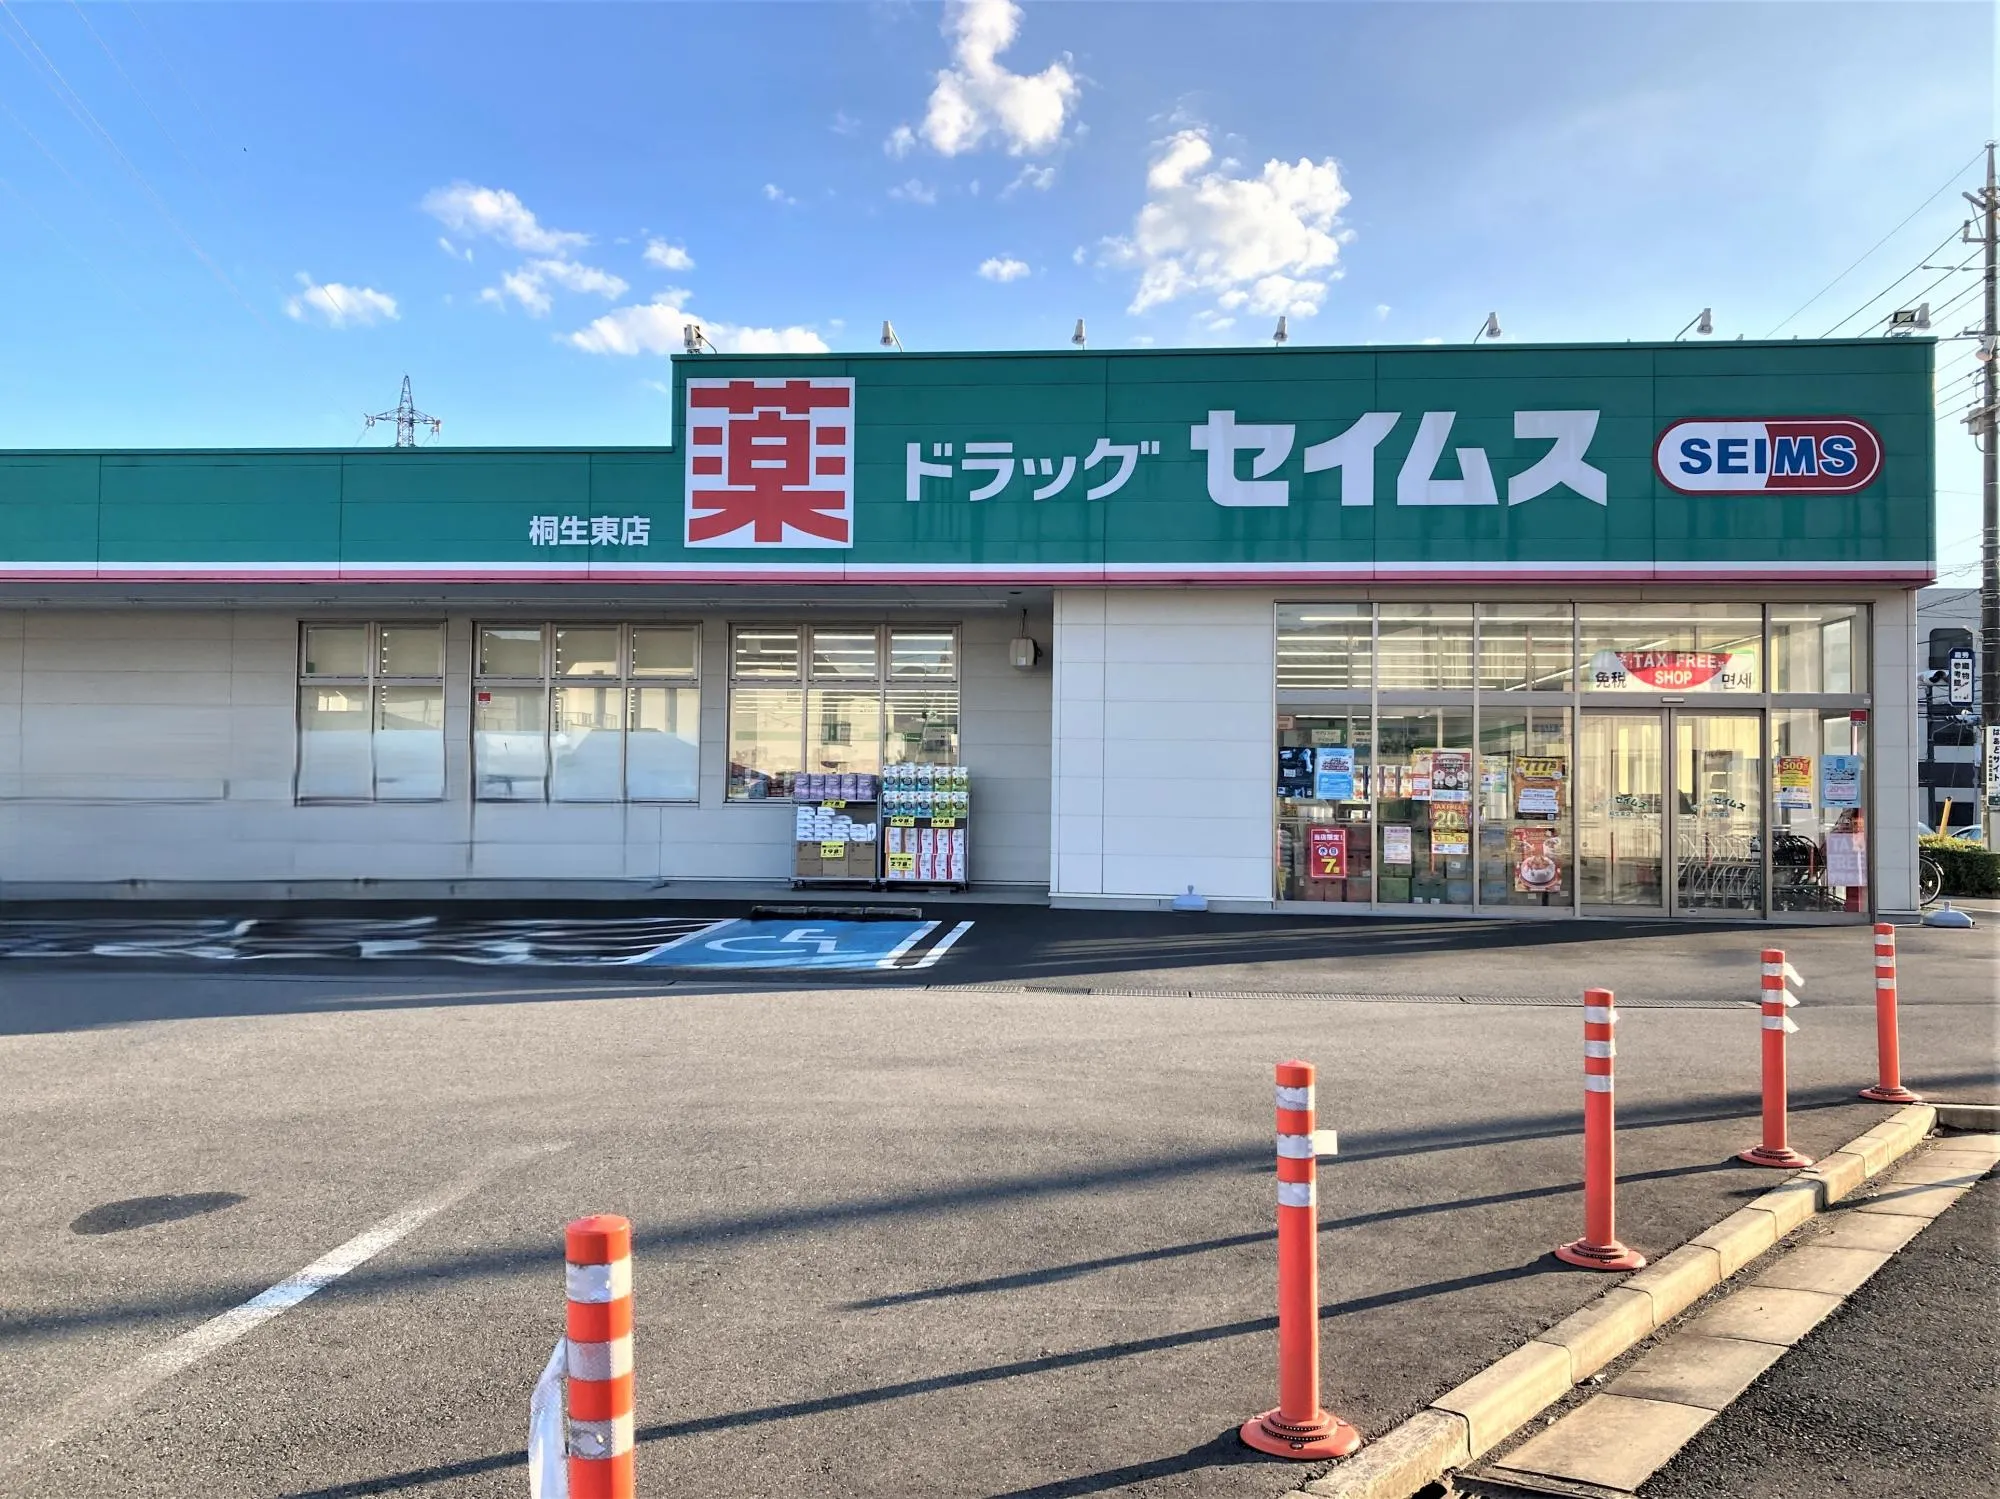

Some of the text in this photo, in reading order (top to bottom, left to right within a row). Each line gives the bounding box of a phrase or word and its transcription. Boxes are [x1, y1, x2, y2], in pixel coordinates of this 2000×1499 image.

[689, 381, 850, 543] 薬
[906, 409, 1607, 507] ドラッグ セイムス
[1679, 435, 1858, 477] SEIMS
[529, 515, 651, 546] 桐生東店
[1633, 652, 1717, 669] TAX FREE
[1595, 671, 1627, 688] 免税
[1655, 670, 1693, 684] SHOP
[1721, 672, 1752, 689] 면세
[1783, 761, 1803, 770] 500
